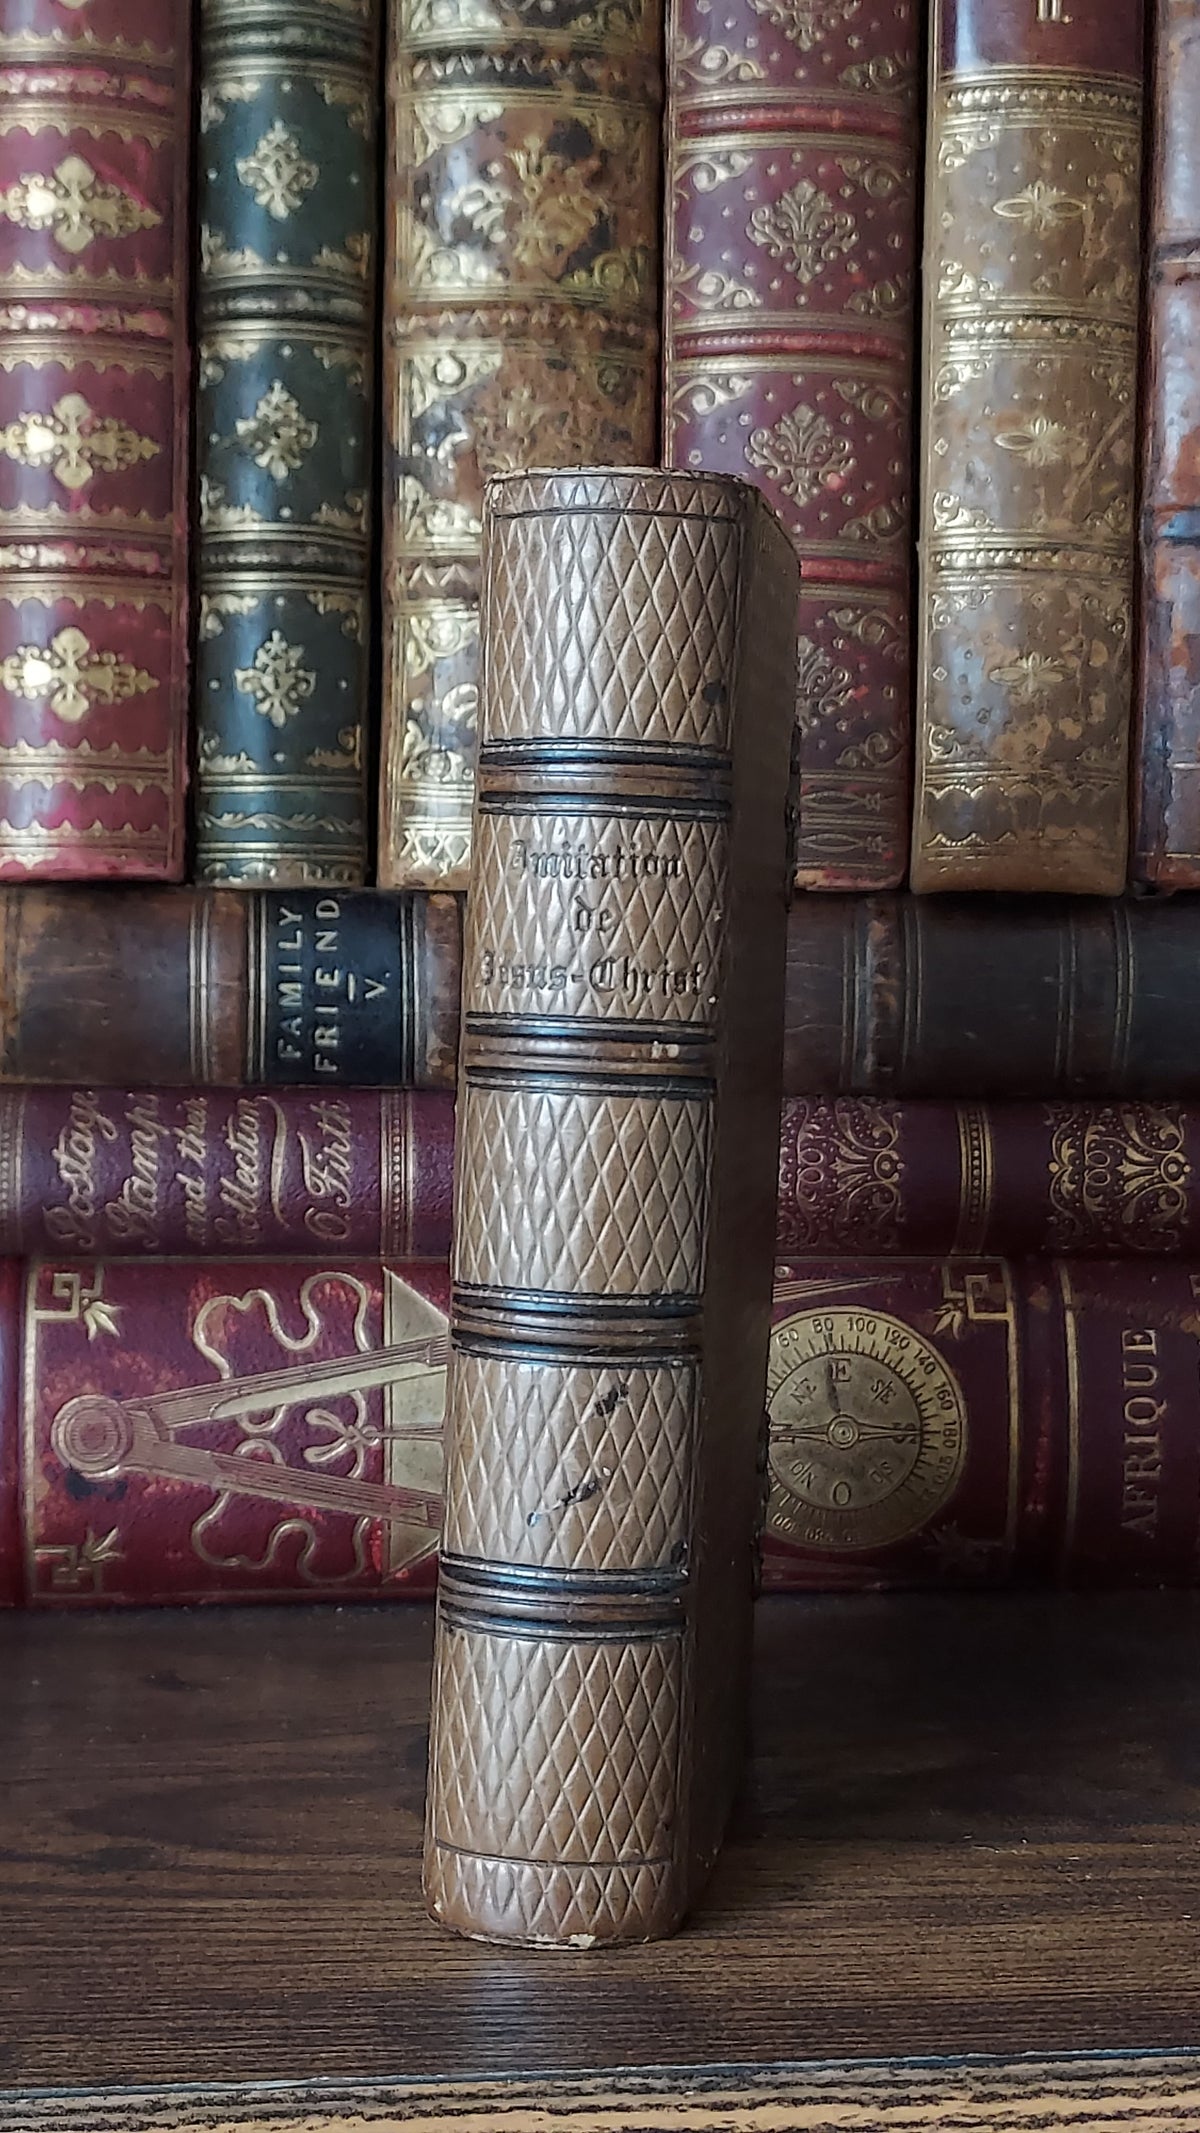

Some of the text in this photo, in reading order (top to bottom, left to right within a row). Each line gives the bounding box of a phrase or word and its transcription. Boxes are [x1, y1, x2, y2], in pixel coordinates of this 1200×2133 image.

[574, 895, 612, 933] de
[277, 906, 303, 1059] FAMILY
[314, 898, 341, 1072] FRIEND
[364, 971, 391, 999] V.
[173, 1096, 208, 1168] their
[43, 1090, 118, 1248] Postage
[105, 1091, 170, 1248] Stamps
[296, 1098, 355, 1208] Firth
[811, 1316, 835, 1333] 80
[846, 1316, 877, 1336] 100
[884, 1325, 912, 1350] 120
[914, 1348, 937, 1376] 140
[933, 1381, 954, 1411] 160
[942, 1421, 958, 1449] 180
[1121, 1329, 1167, 1539] AFRIQUE
